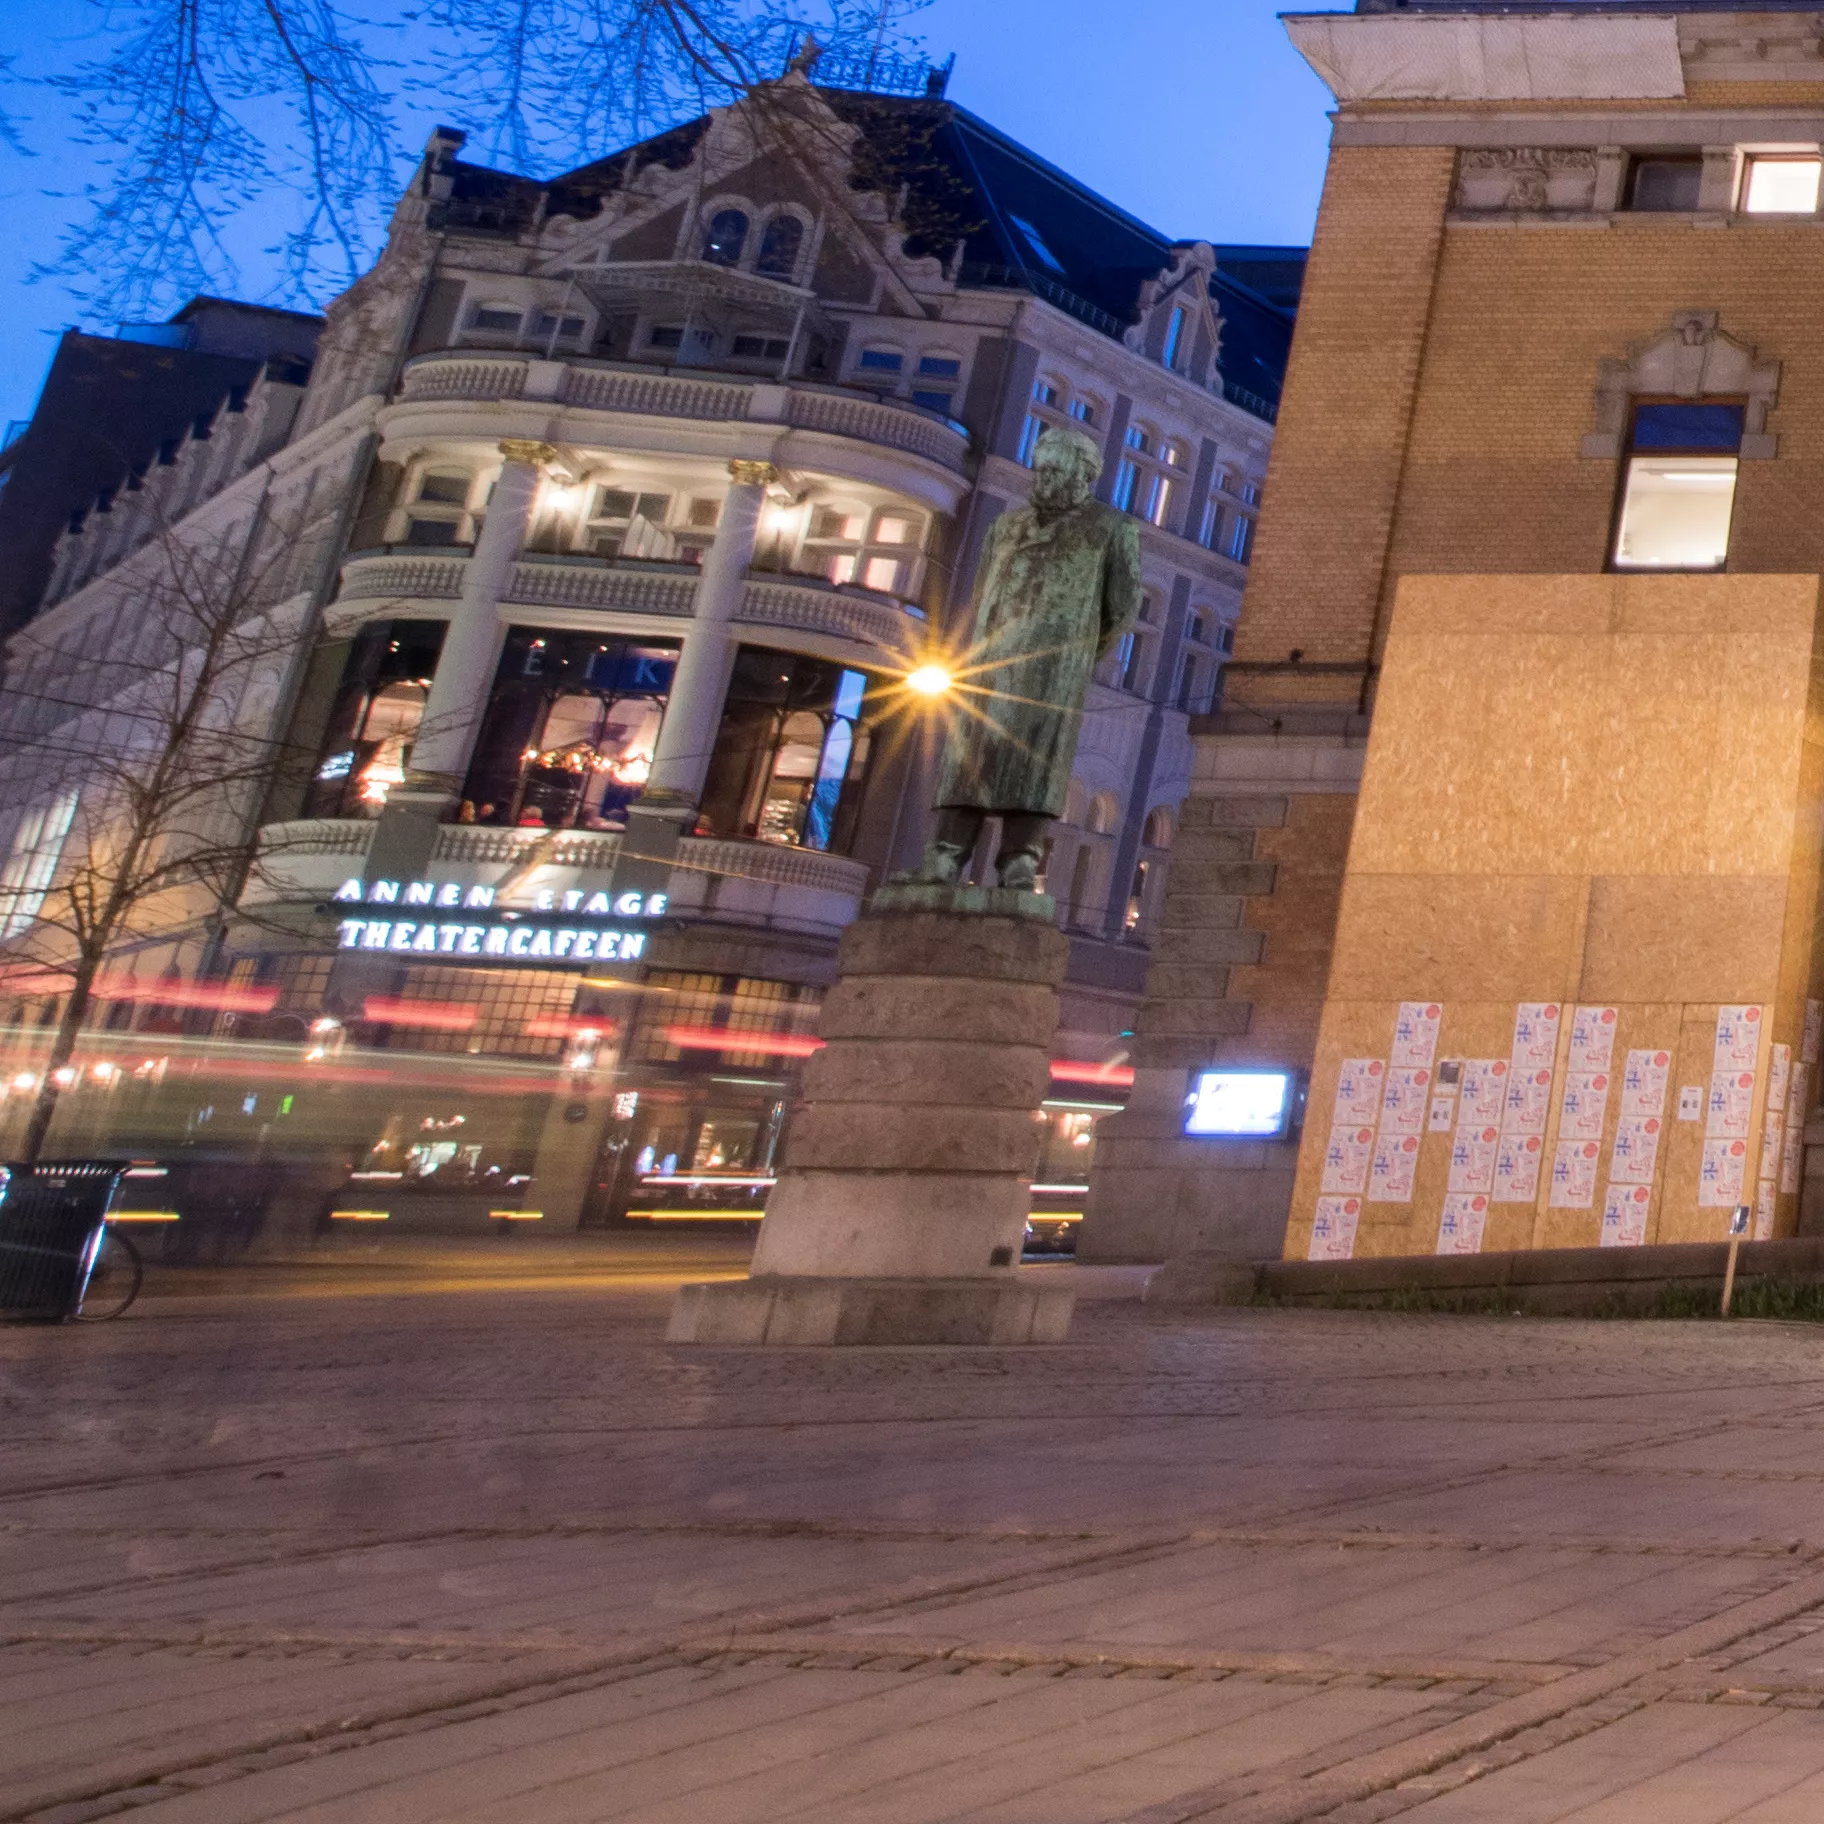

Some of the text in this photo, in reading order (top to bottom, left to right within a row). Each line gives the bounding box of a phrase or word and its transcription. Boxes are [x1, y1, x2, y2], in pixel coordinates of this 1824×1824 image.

[333, 878, 669, 916] ANNEN ETAGE
[337, 919, 646, 959] THEATERCAFEEN
